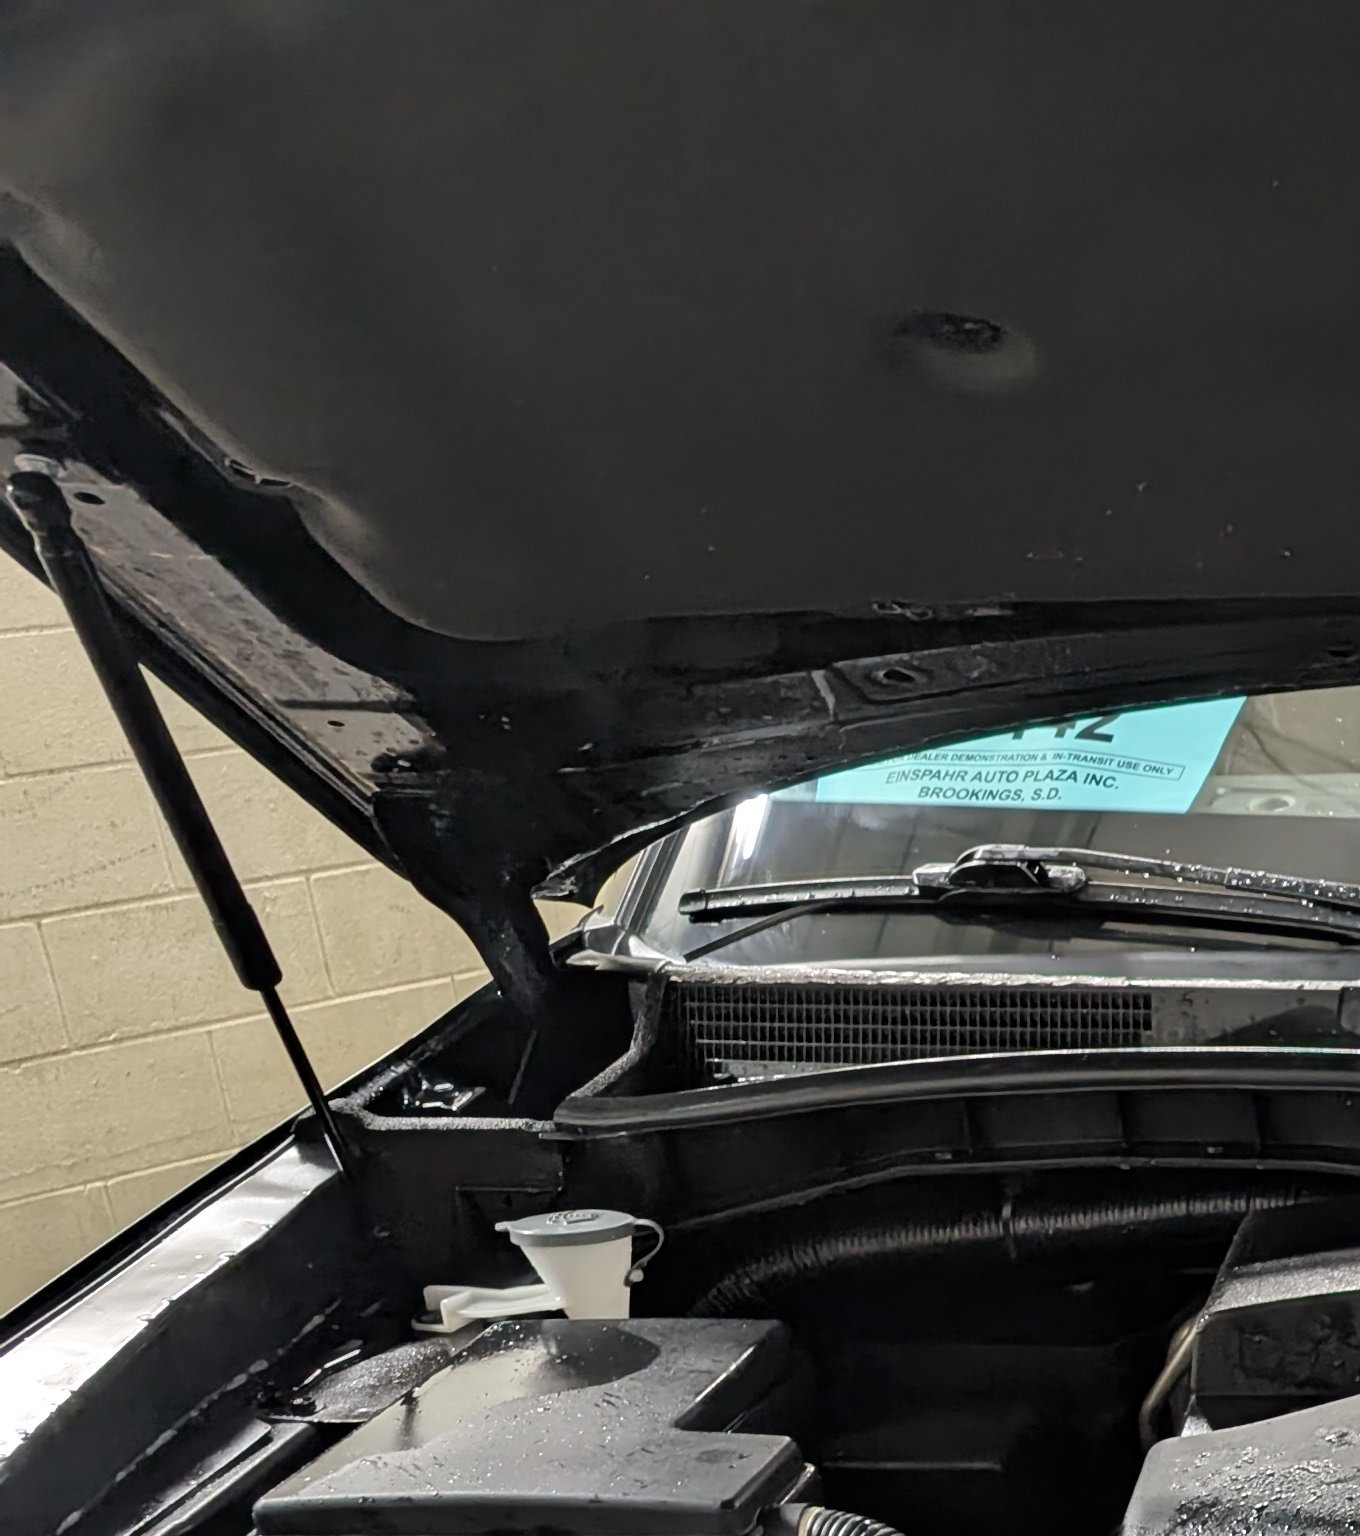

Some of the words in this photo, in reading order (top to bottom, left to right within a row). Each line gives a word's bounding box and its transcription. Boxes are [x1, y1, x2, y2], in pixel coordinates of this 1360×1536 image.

[907, 751, 949, 761] DEALER
[951, 752, 1038, 762] DEMONSTRATION
[1040, 753, 1048, 761] &
[1052, 751, 1114, 767] IN-TRANSIT
[1116, 761, 1140, 771] USE
[1142, 764, 1175, 776] ONLY
[885, 768, 968, 785] EINSPAHR
[969, 770, 1019, 784] AUTO
[1022, 768, 1078, 783] PLAZA
[1083, 772, 1119, 790] INC.
[917, 785, 1025, 803] BROOKINGS,
[1031, 786, 1062, 801] S.D.
